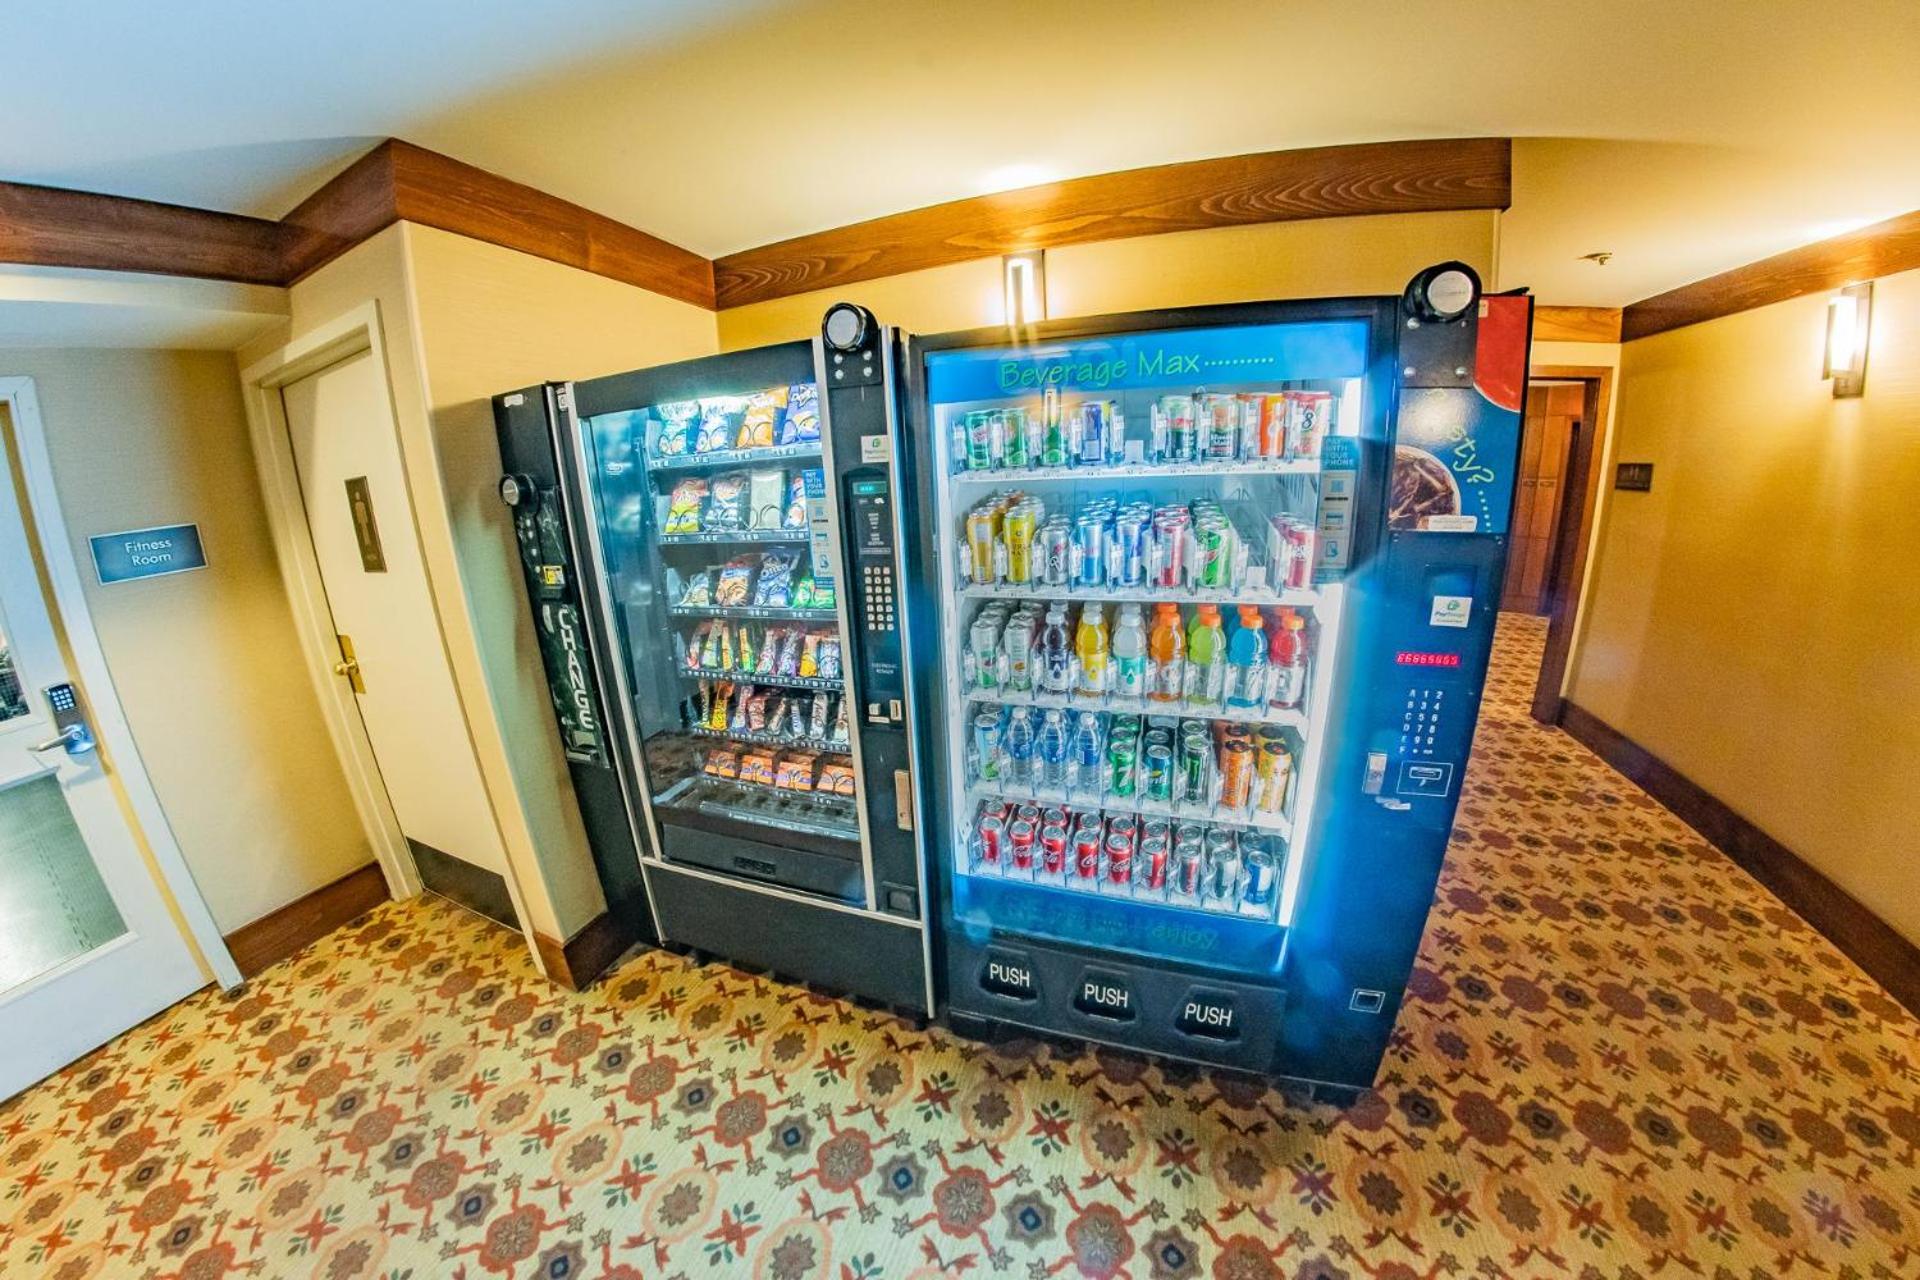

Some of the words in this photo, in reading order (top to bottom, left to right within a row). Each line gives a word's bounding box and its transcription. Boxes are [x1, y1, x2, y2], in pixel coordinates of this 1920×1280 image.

[1001, 360, 1127, 388] Beverage
[124, 539, 172, 554] Fitness
[131, 553, 171, 566] Room
[557, 607, 594, 730] CHANGE
[989, 963, 1031, 988] PUSH
[1084, 983, 1129, 1008] PUSH
[1184, 1002, 1233, 1028] PUSH
